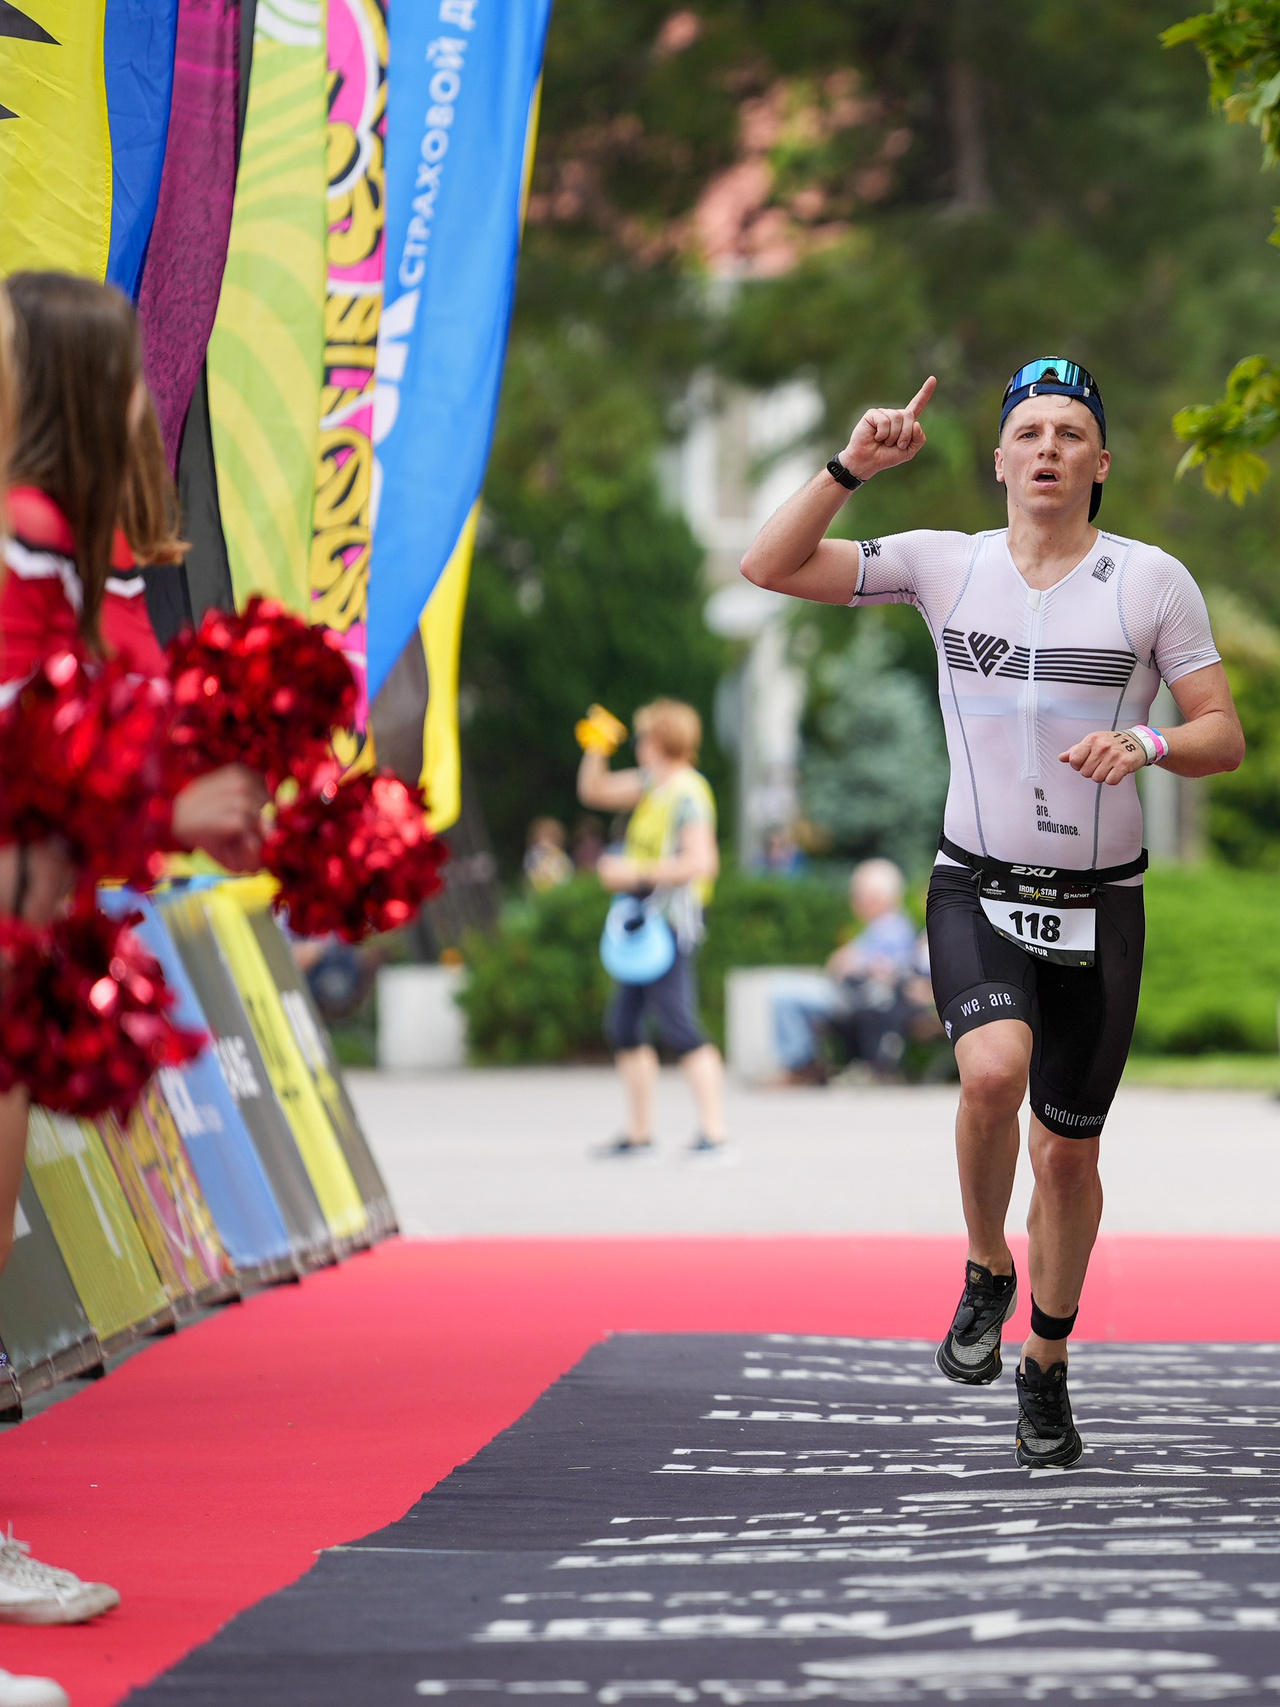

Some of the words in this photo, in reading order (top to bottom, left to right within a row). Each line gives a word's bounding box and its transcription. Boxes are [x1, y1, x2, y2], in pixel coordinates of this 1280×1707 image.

[398, 35, 468, 287] СТРАХОВОЙ
[1113, 732, 1137, 752] 118
[1036, 805, 1051, 818] are.
[1038, 820, 1081, 836] endurance.
[1010, 865, 1057, 878] 2XU
[1018, 884, 1034, 893] IRON
[1040, 888, 1057, 897] STAR
[1009, 910, 1061, 943] 118
[1025, 943, 1048, 957] ARTUR
[961, 998, 985, 1017] we.
[989, 992, 1016, 1007] are.
[1044, 1103, 1106, 1127] endurance
[662, 1464, 966, 1474] IRON
